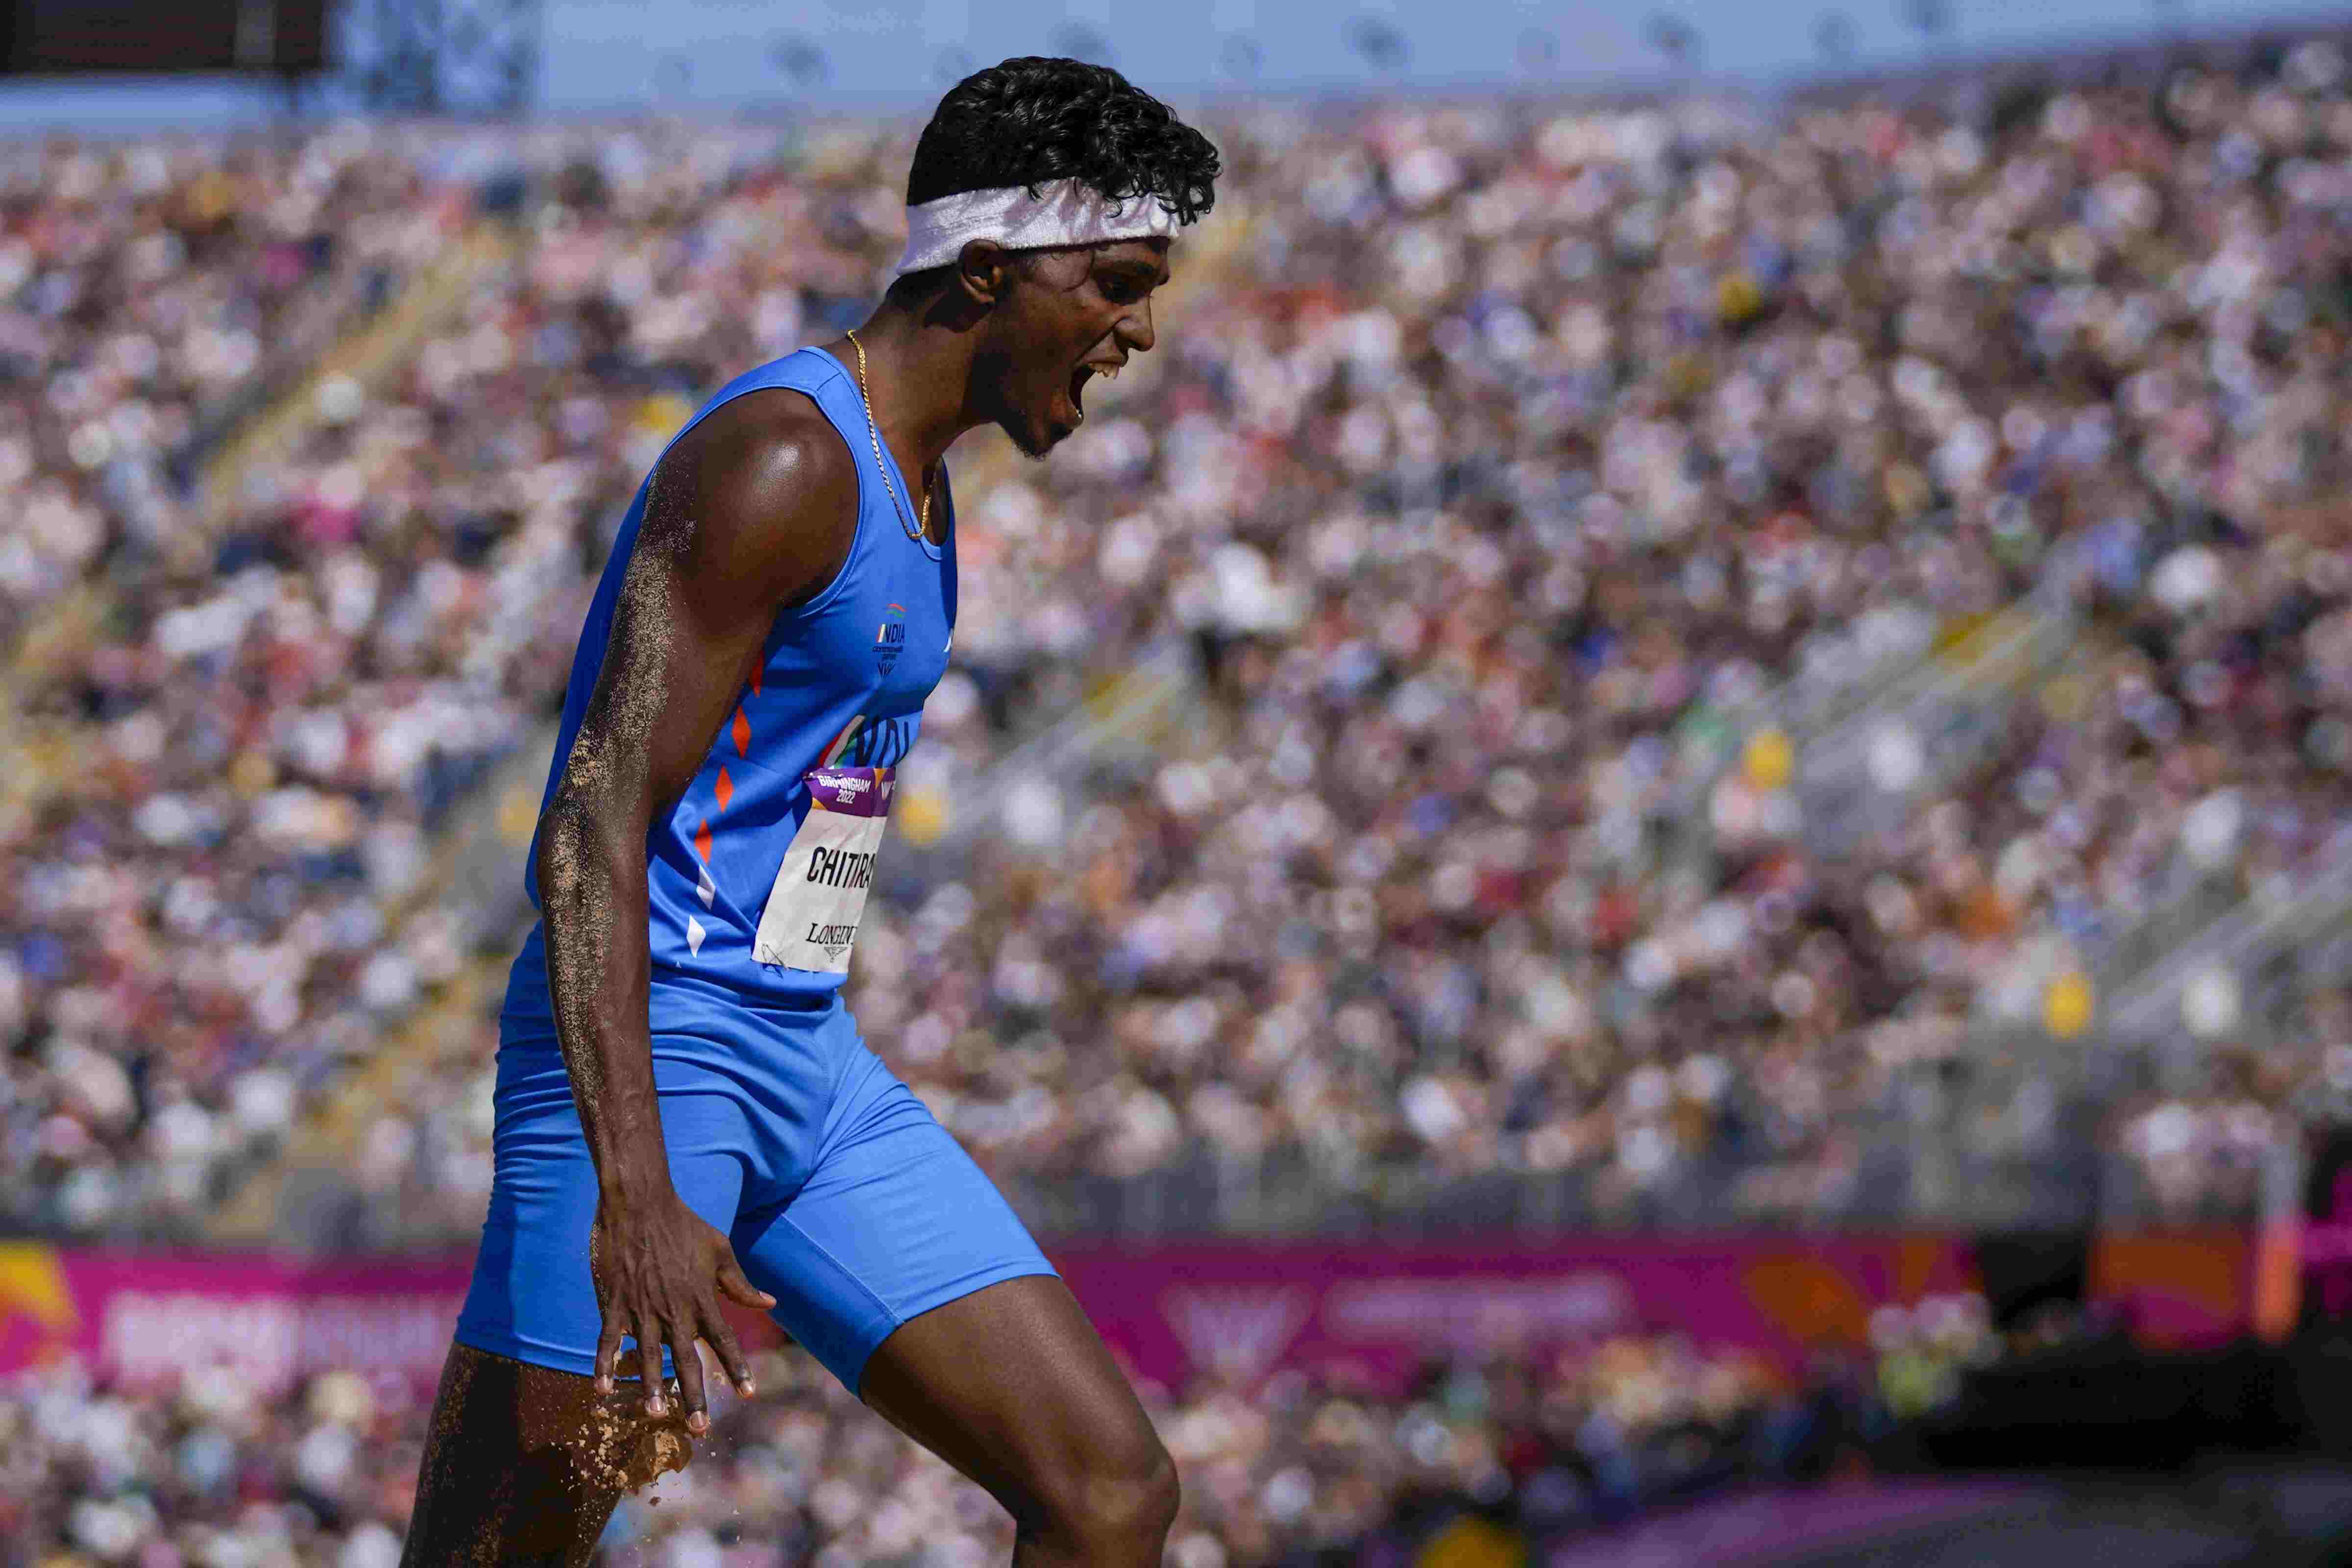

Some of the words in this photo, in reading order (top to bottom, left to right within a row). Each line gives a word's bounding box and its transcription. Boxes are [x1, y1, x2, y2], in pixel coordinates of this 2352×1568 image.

[876, 623, 906, 644] INDIA
[836, 789, 856, 804] 2022
[806, 923, 858, 945] LONGIN
